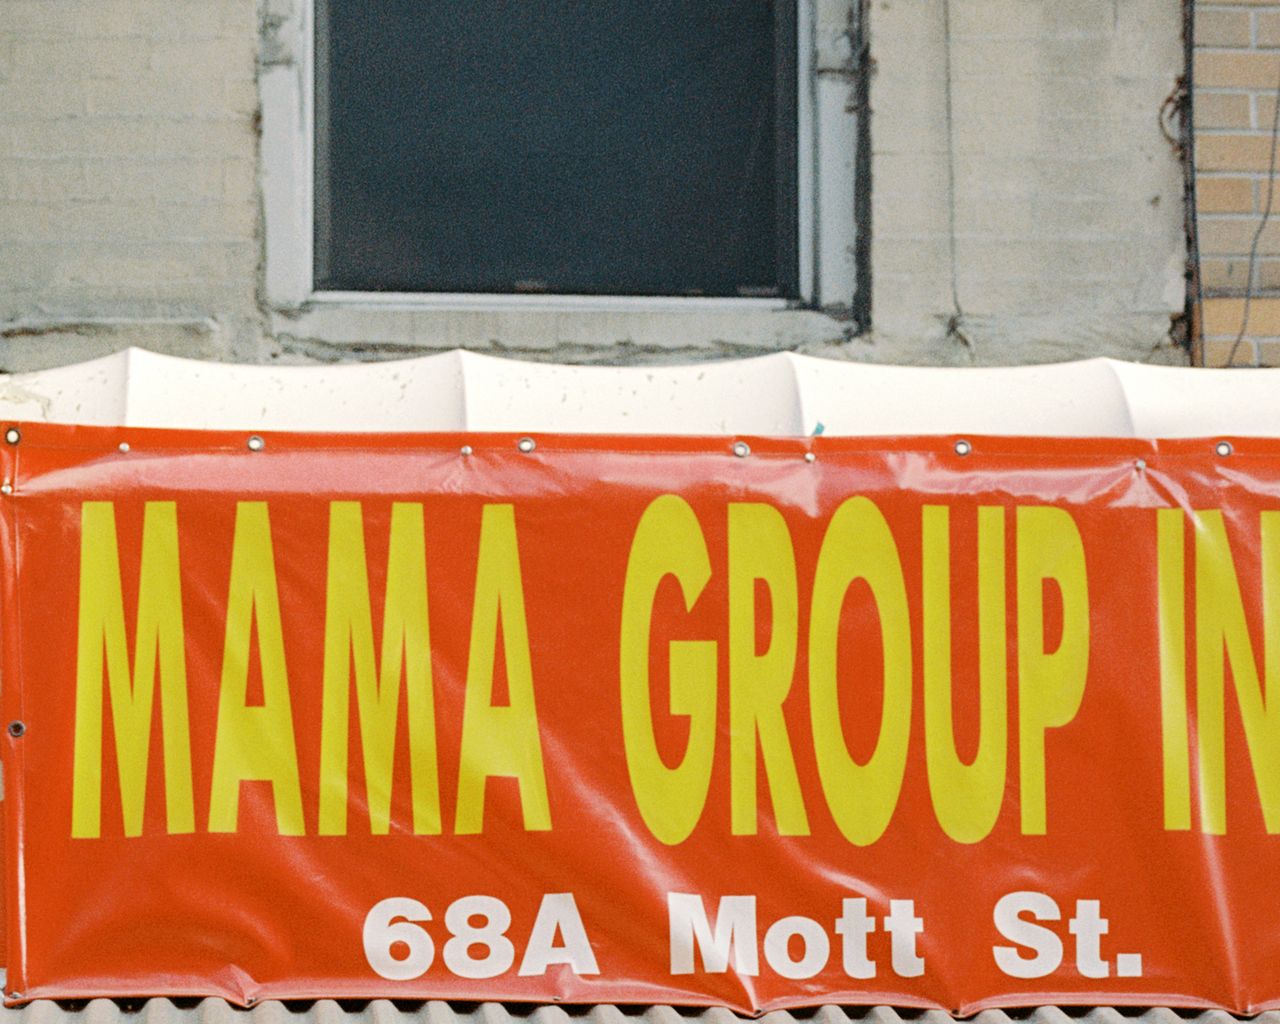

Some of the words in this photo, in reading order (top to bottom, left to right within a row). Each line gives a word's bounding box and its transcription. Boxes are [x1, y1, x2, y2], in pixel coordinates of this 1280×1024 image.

[71, 501, 552, 839] MAMA
[620, 494, 1090, 846] GROUP
[1157, 508, 1280, 836] IN
[362, 893, 600, 980] 68A
[667, 892, 924, 979] Mott
[993, 891, 1142, 979] St.
